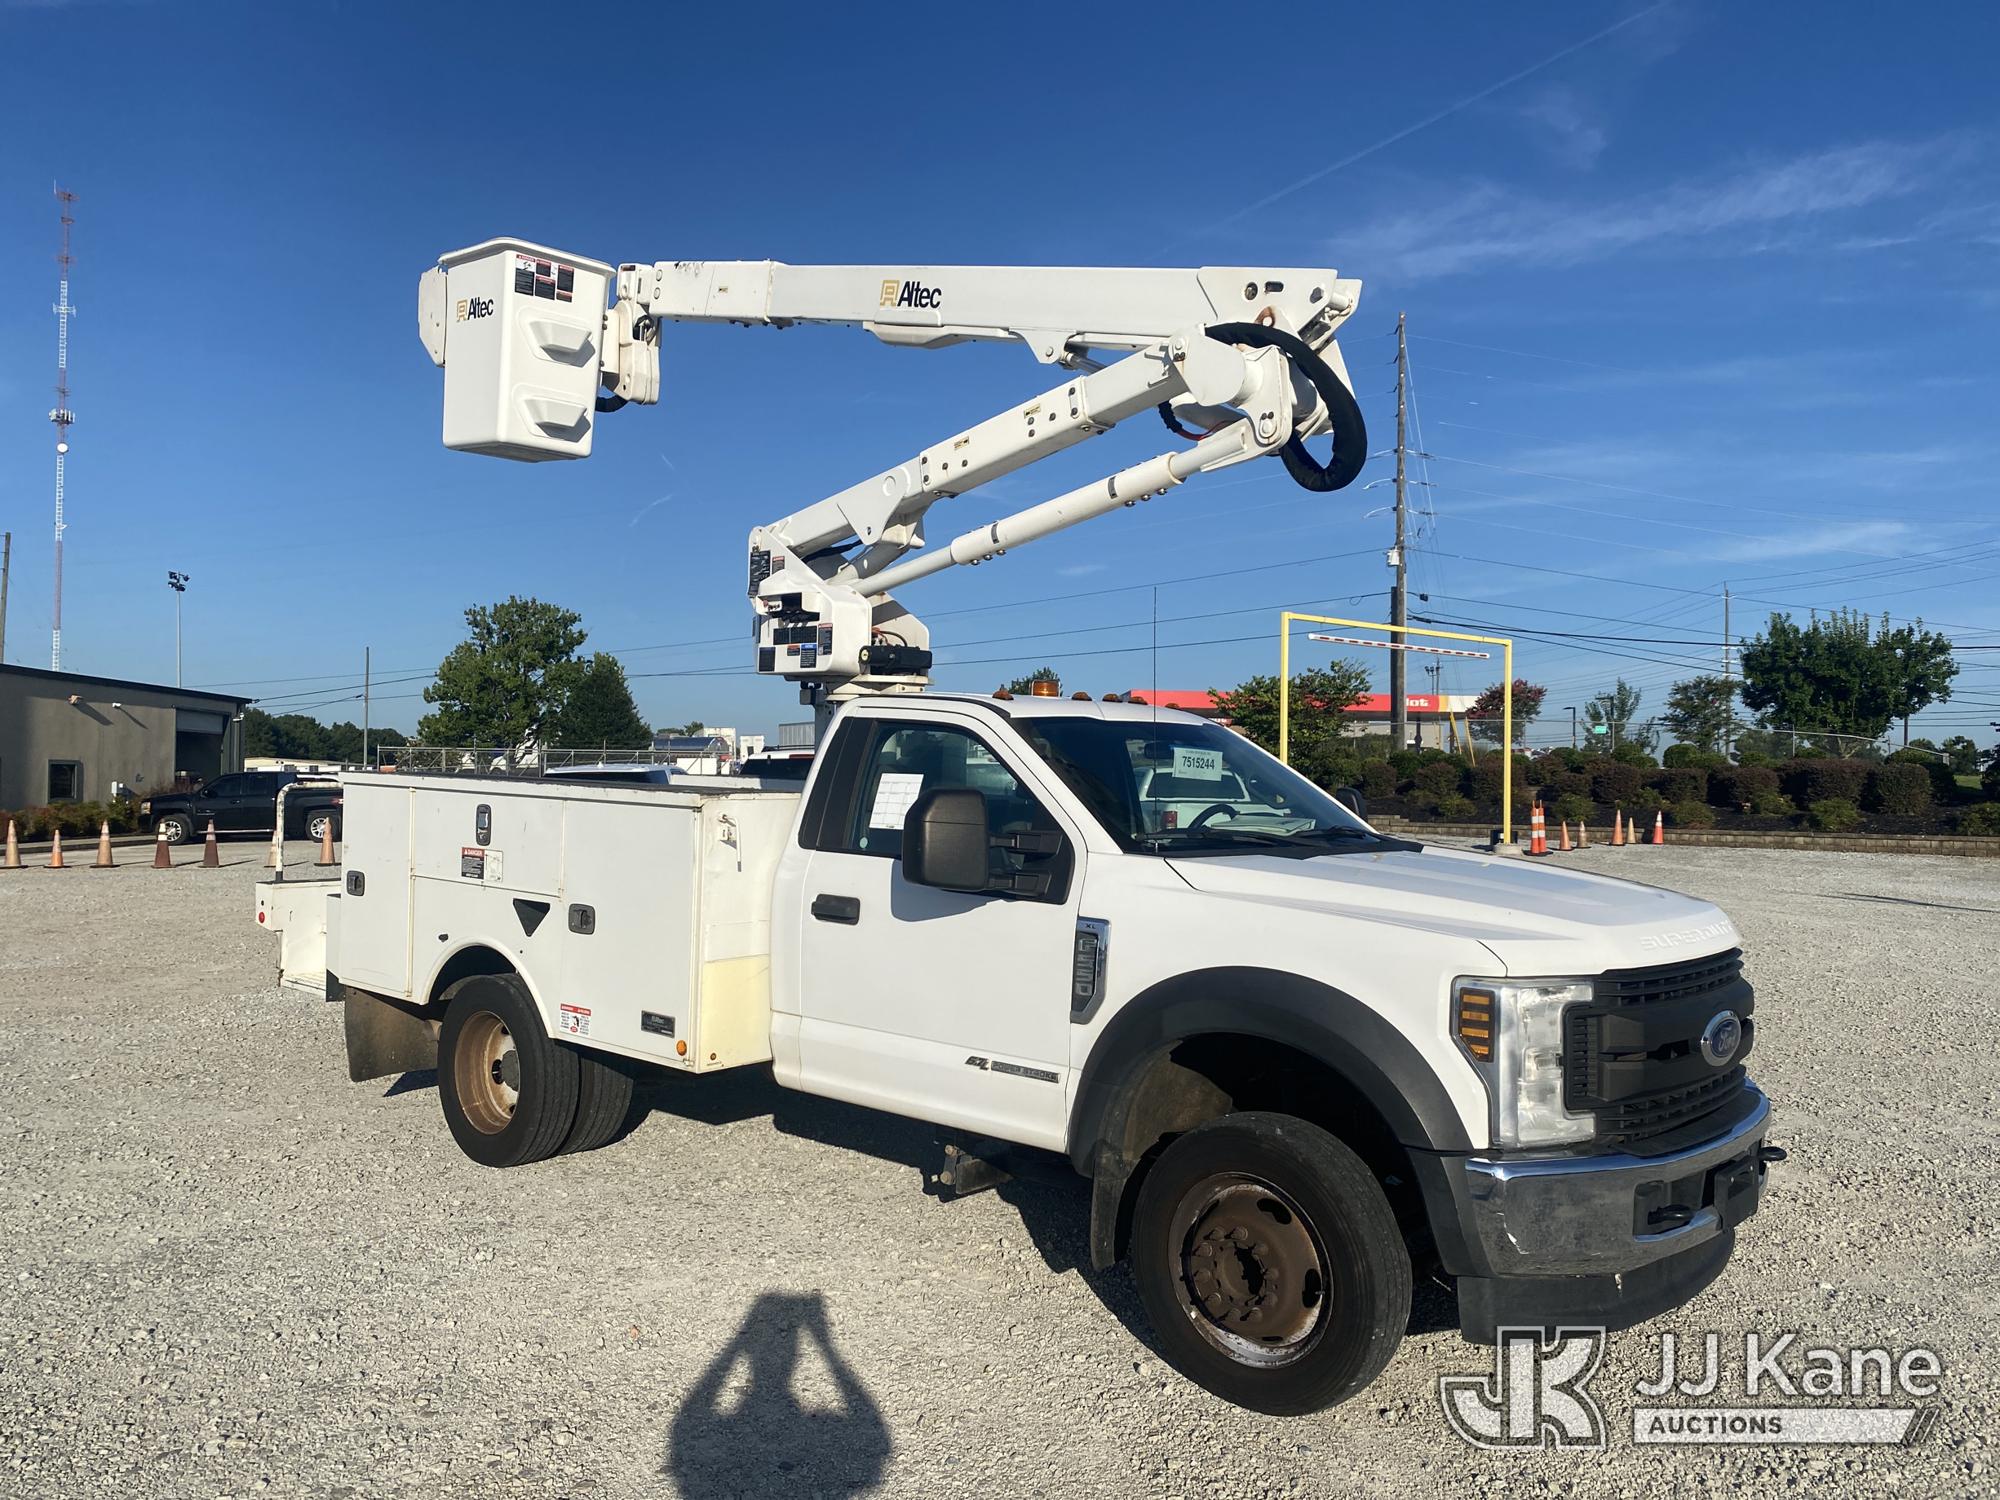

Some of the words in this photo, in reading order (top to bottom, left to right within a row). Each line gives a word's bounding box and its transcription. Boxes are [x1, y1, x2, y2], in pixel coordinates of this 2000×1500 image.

[898, 280, 942, 309] Altec
[467, 296, 494, 320] Altec
[1406, 698, 1429, 707] lot
[1182, 755, 1215, 770] 7515244
